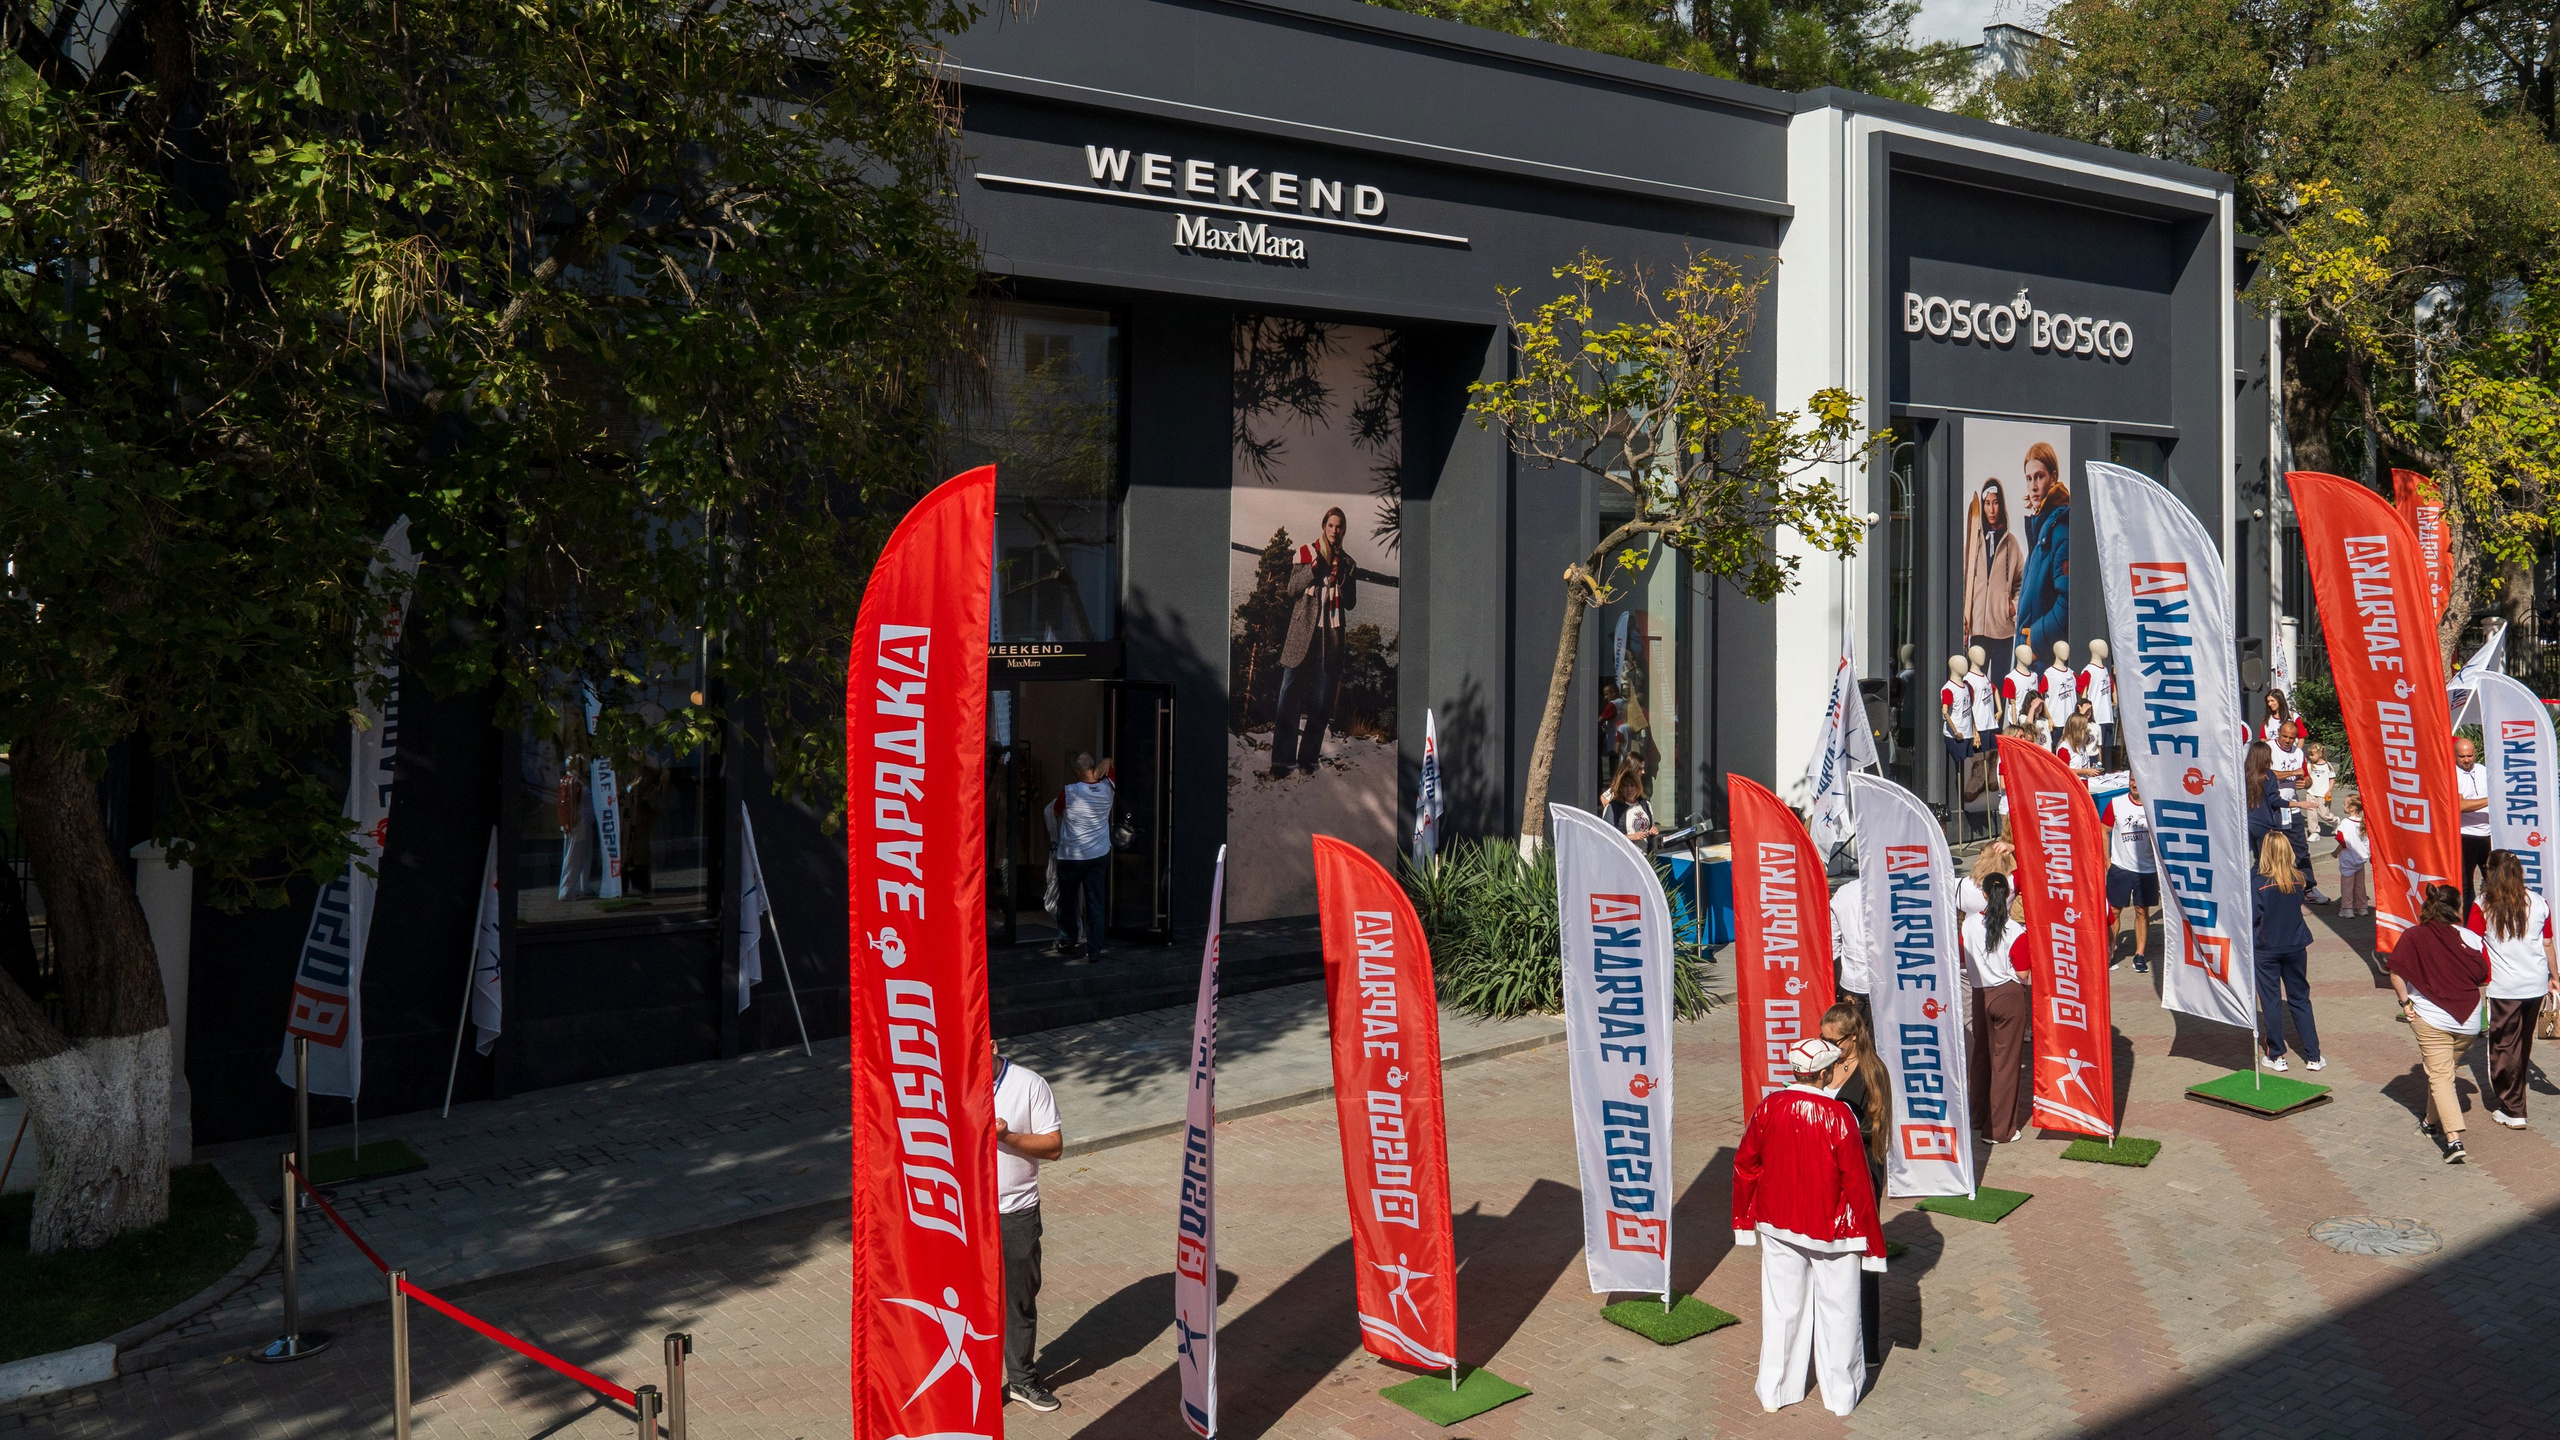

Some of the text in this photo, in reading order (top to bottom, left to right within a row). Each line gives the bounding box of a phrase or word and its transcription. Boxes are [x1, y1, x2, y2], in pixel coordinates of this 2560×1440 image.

[1085, 144, 1386, 217] WEEKEND
[1173, 213, 1306, 261] MaxMara
[1904, 291, 2134, 358] BOSCO BOSCO
[988, 645, 1063, 655] WEEKEND
[1007, 659, 1041, 668] MaxMara
[874, 624, 966, 1244] BOSCO ЗАРЯДКА
